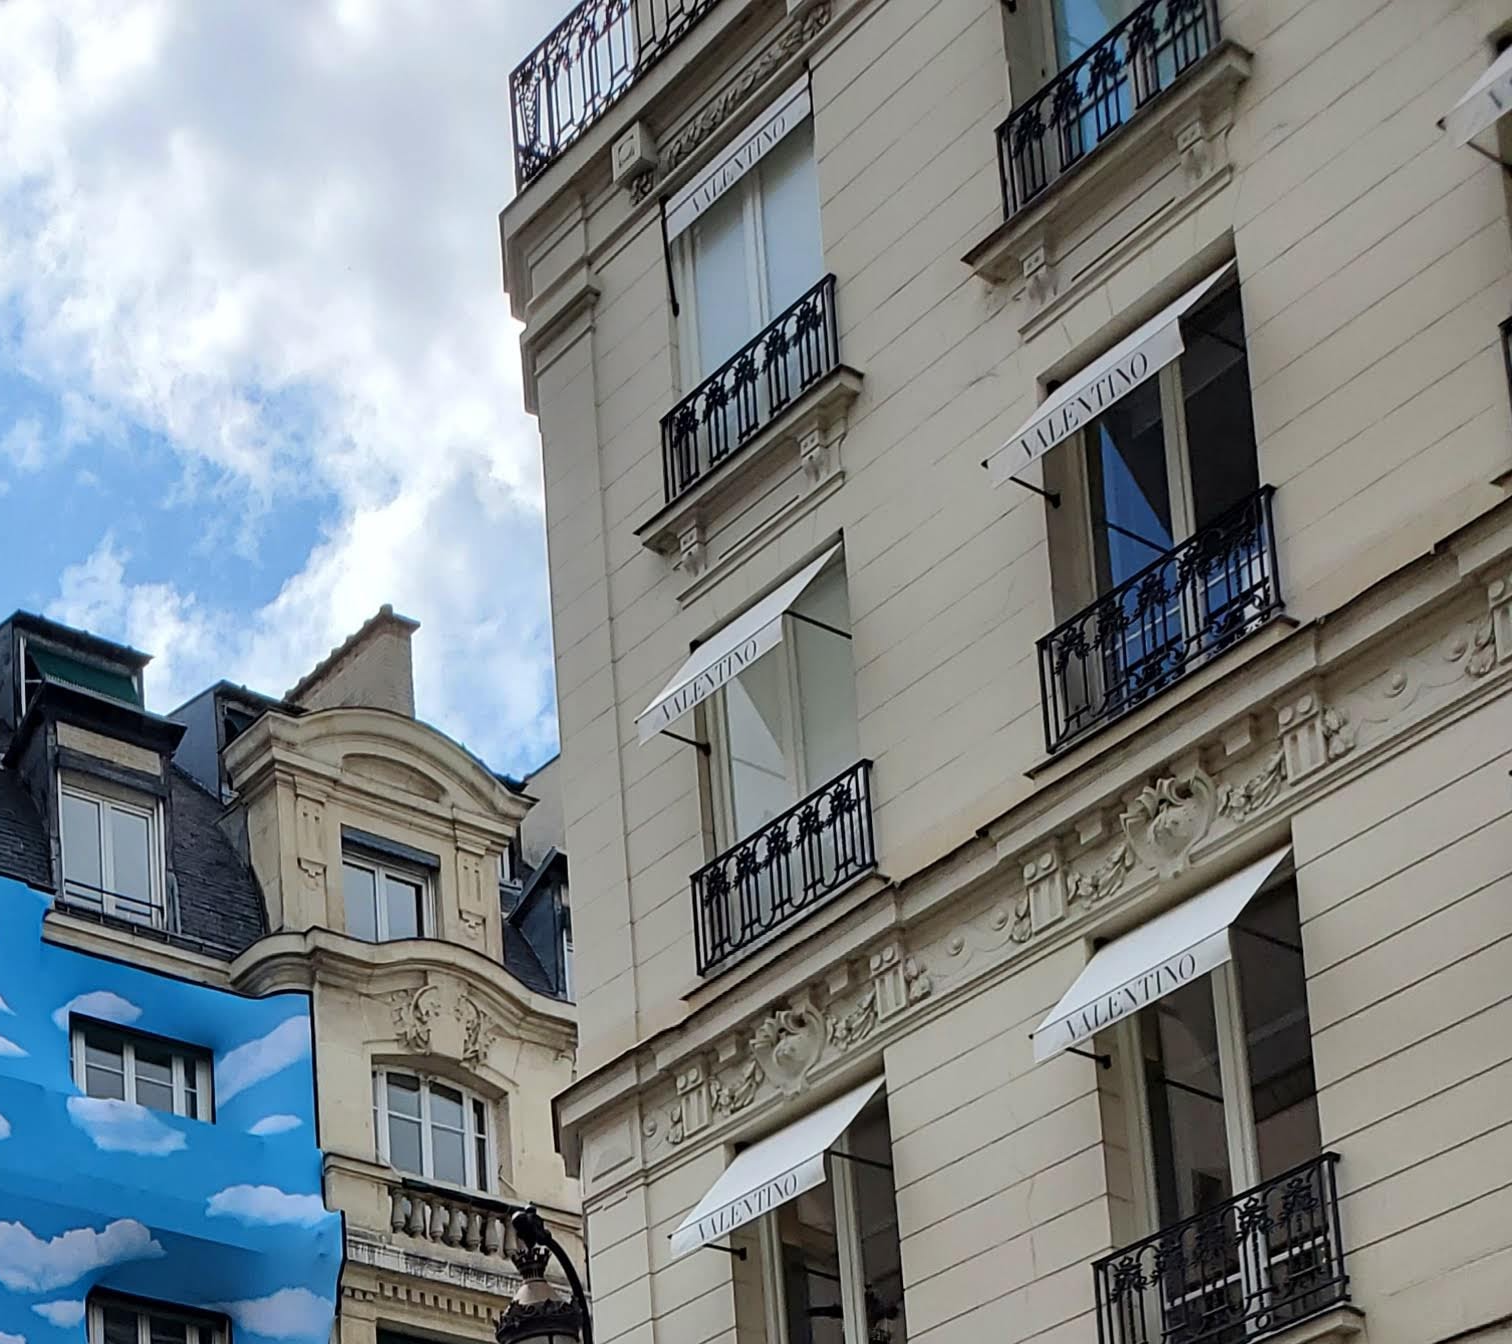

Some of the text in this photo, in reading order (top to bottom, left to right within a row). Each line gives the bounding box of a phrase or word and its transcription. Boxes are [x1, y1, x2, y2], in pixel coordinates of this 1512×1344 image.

[692, 116, 787, 213] VALENTINO
[1020, 350, 1149, 459] VALENTINO
[661, 639, 758, 721] VALENTINO
[1065, 952, 1196, 1040] VALENTINO
[698, 1172, 798, 1241] VALENTINO
